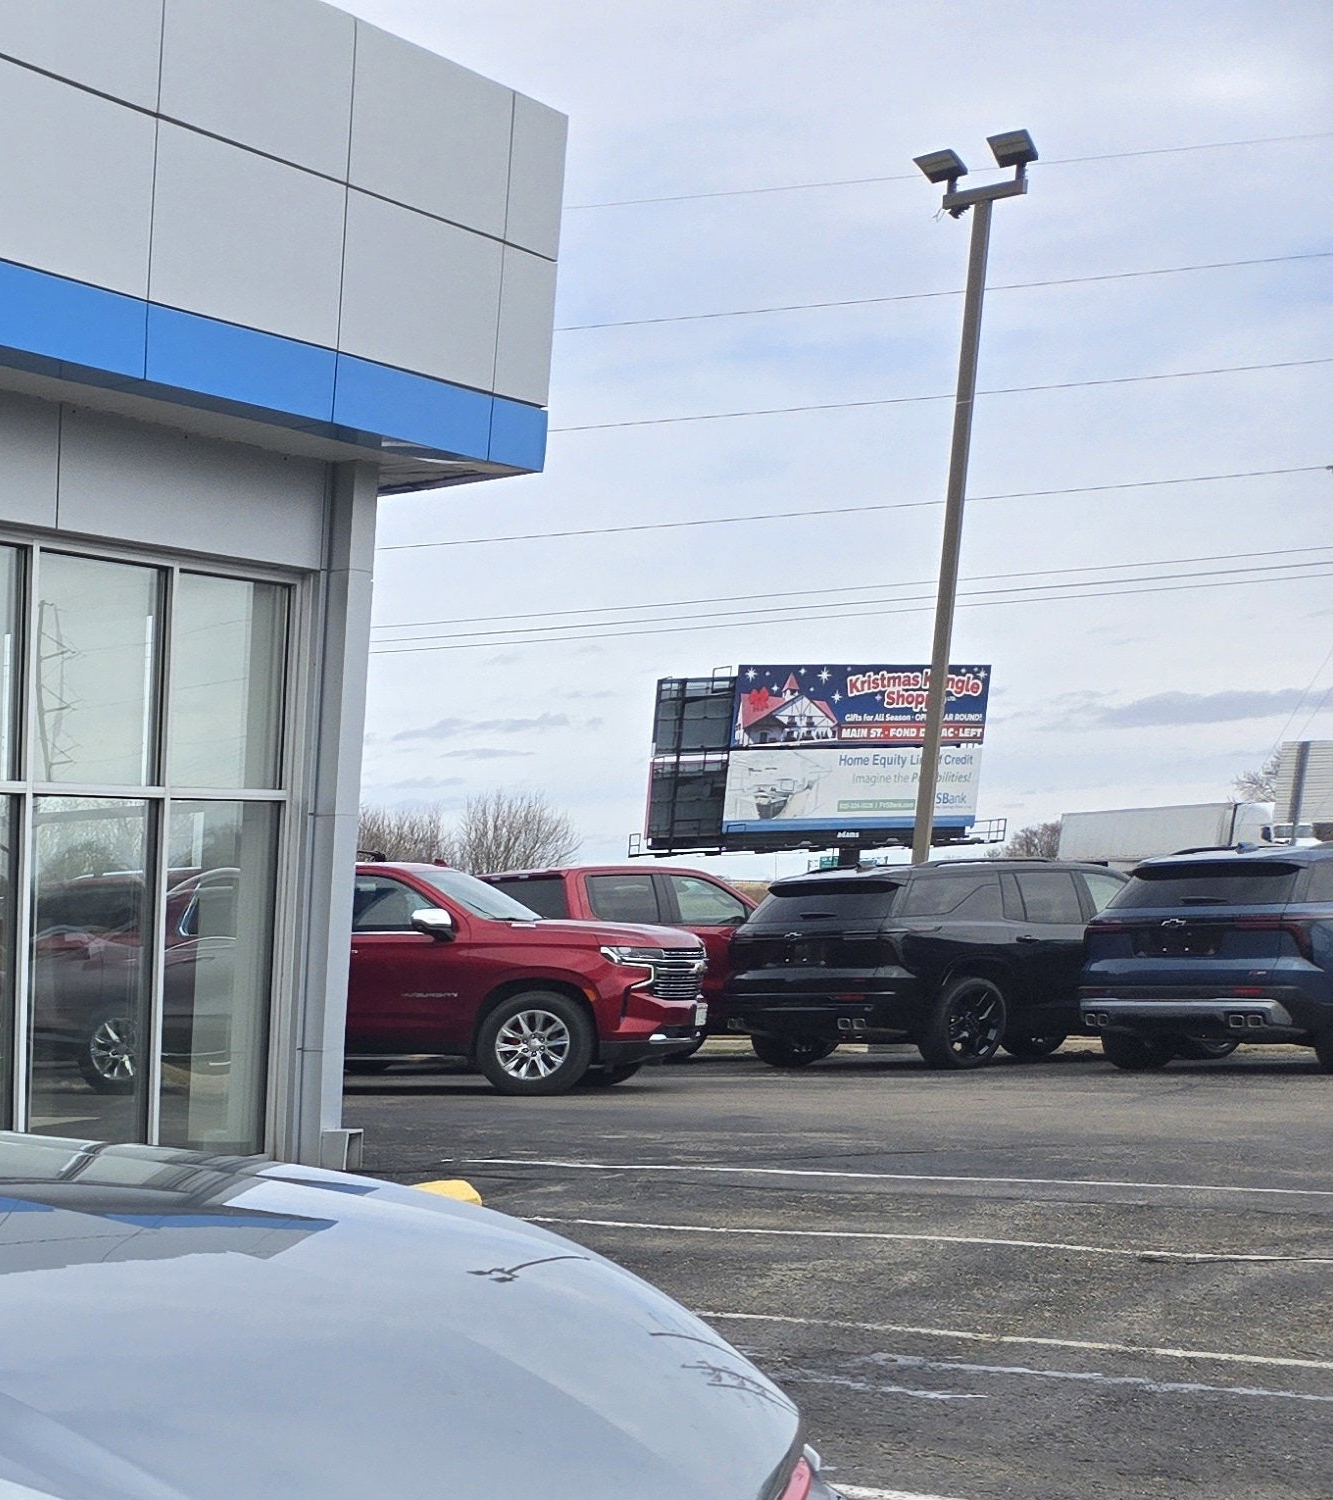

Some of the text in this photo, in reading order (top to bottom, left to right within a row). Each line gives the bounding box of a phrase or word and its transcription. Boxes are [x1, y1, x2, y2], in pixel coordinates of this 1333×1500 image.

[847, 669, 982, 697] Kristmas Kngle
[885, 689, 931, 711] Shopp
[841, 728, 867, 738] MAIN
[870, 728, 884, 738] ST.
[890, 728, 917, 738] FOND
[941, 728, 954, 737] AC
[959, 728, 983, 737] LEFT
[839, 754, 869, 766] Home
[872, 754, 907, 768] Equity
[944, 754, 973, 765] Credit
[852, 772, 972, 786] Imagine the Pbilities!
[935, 793, 967, 804] SBank
